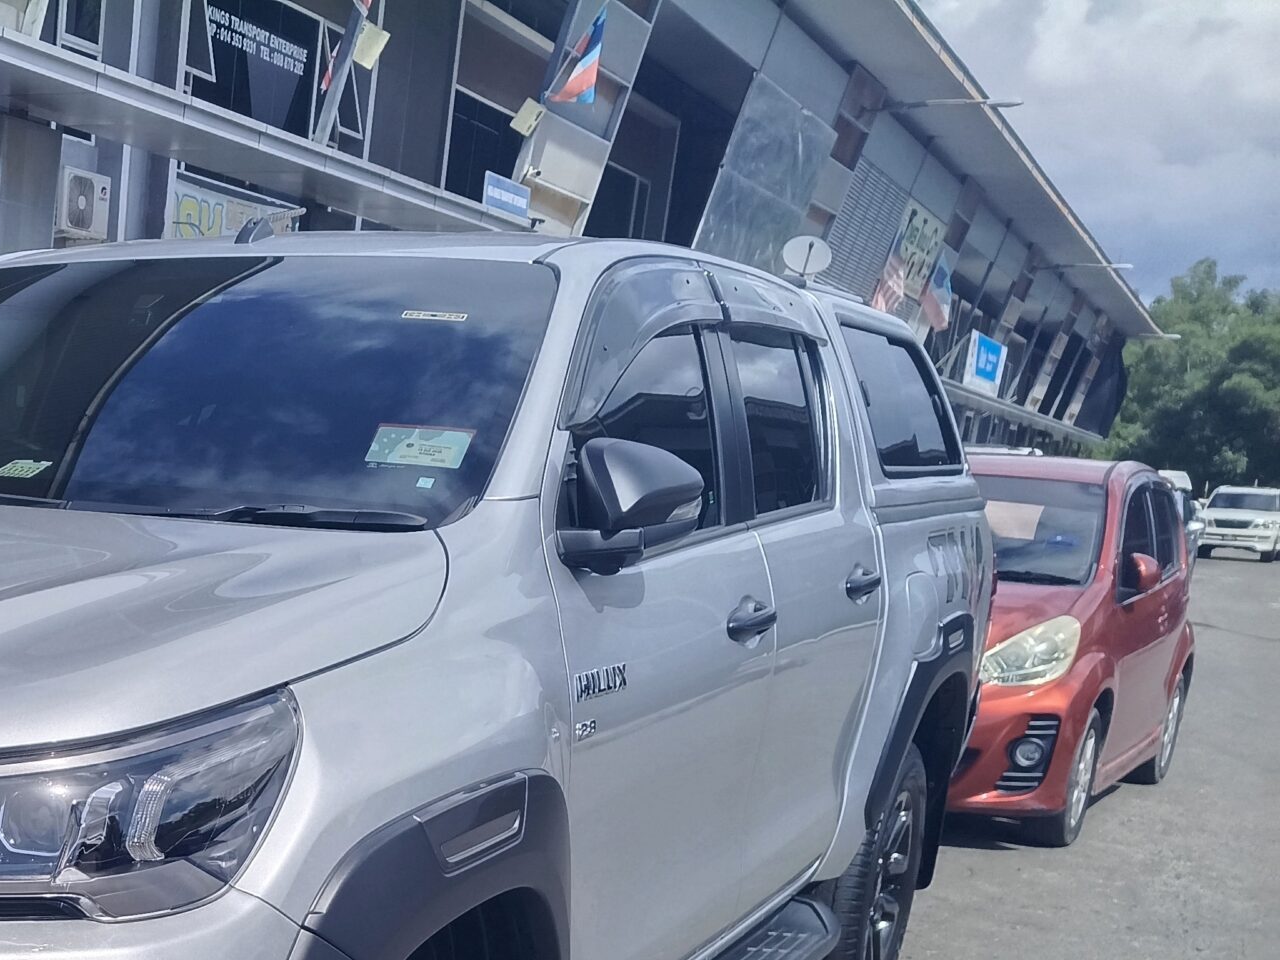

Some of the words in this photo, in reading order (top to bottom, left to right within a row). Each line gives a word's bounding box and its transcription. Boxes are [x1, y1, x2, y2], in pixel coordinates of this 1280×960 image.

[208, 5, 230, 27] KINGS
[231, 15, 270, 45] TRANSPORT
[270, 34, 308, 62] ENTERPRISE
[574, 662, 627, 702] HILUX
